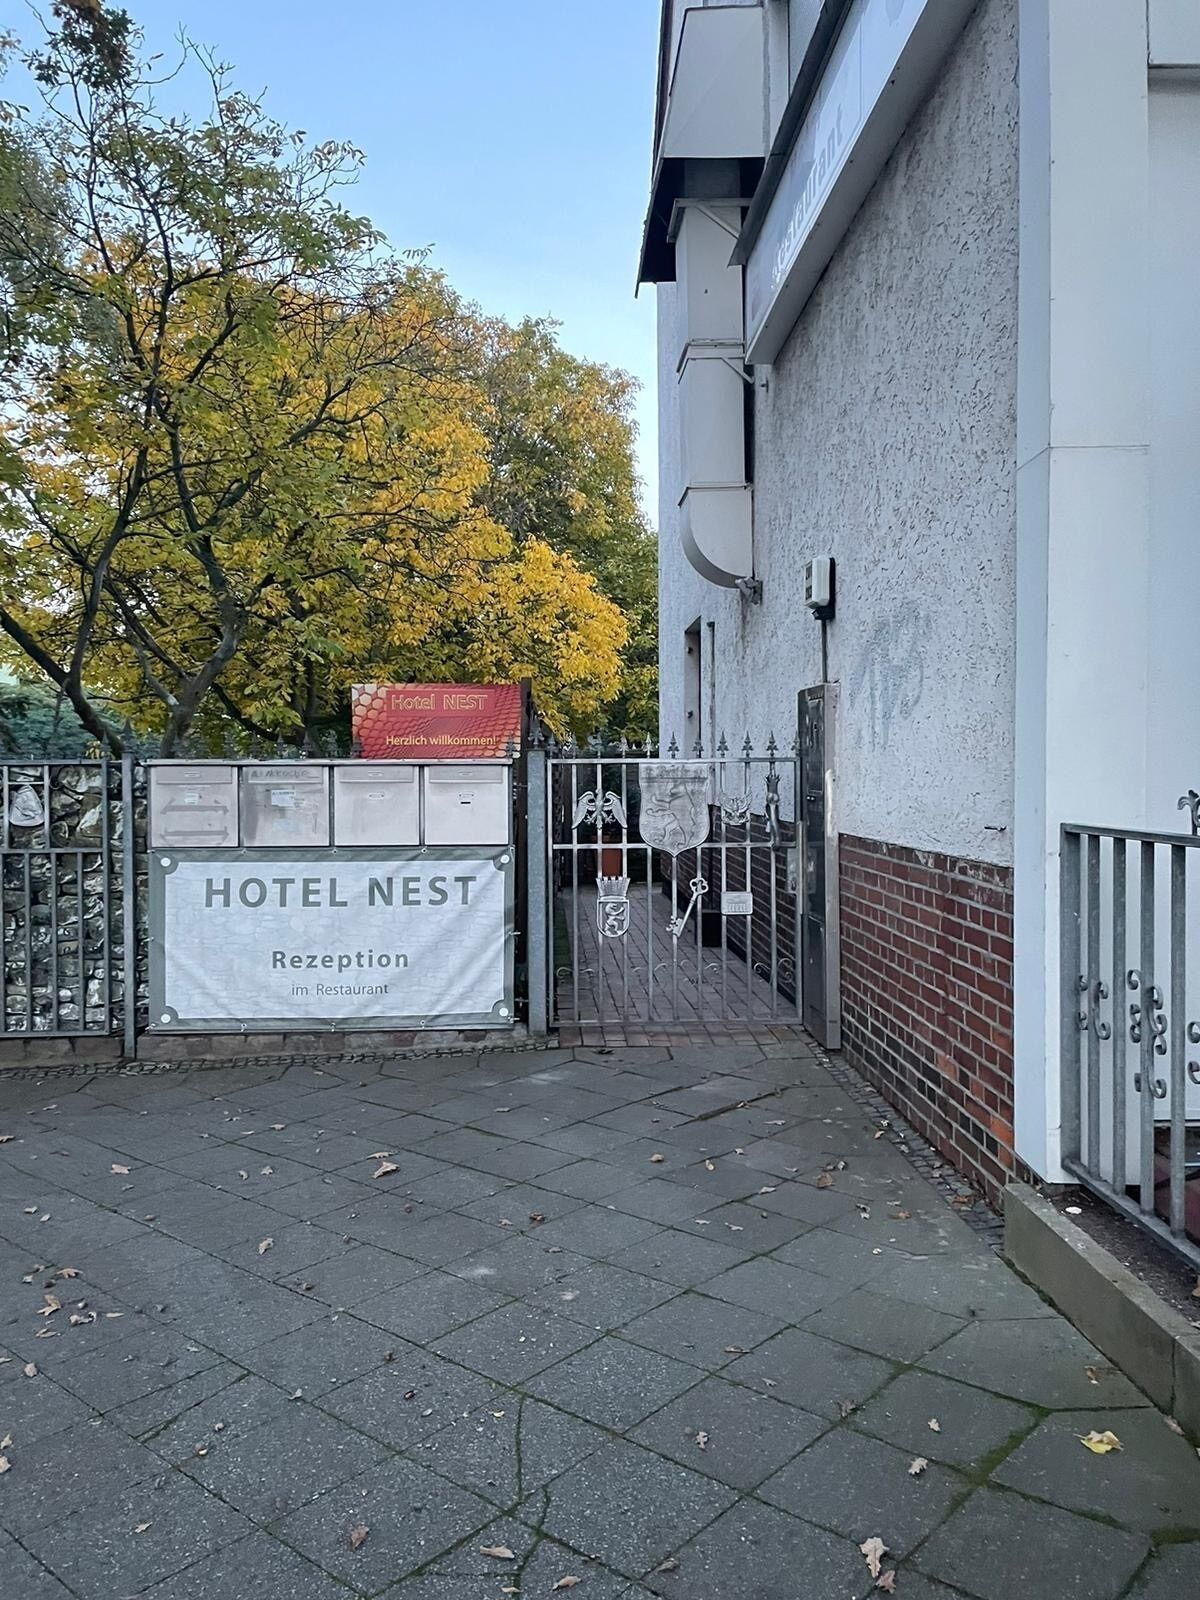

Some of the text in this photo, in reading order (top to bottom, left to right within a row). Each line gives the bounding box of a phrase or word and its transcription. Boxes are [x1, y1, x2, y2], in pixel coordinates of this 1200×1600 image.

[391, 693, 488, 711] Hotel NEST
[386, 734, 497, 746] Herzlich willkommen!
[204, 875, 477, 908] HOTEL NEST
[271, 949, 409, 973] Rezeption
[291, 982, 389, 996] im Restaurant
